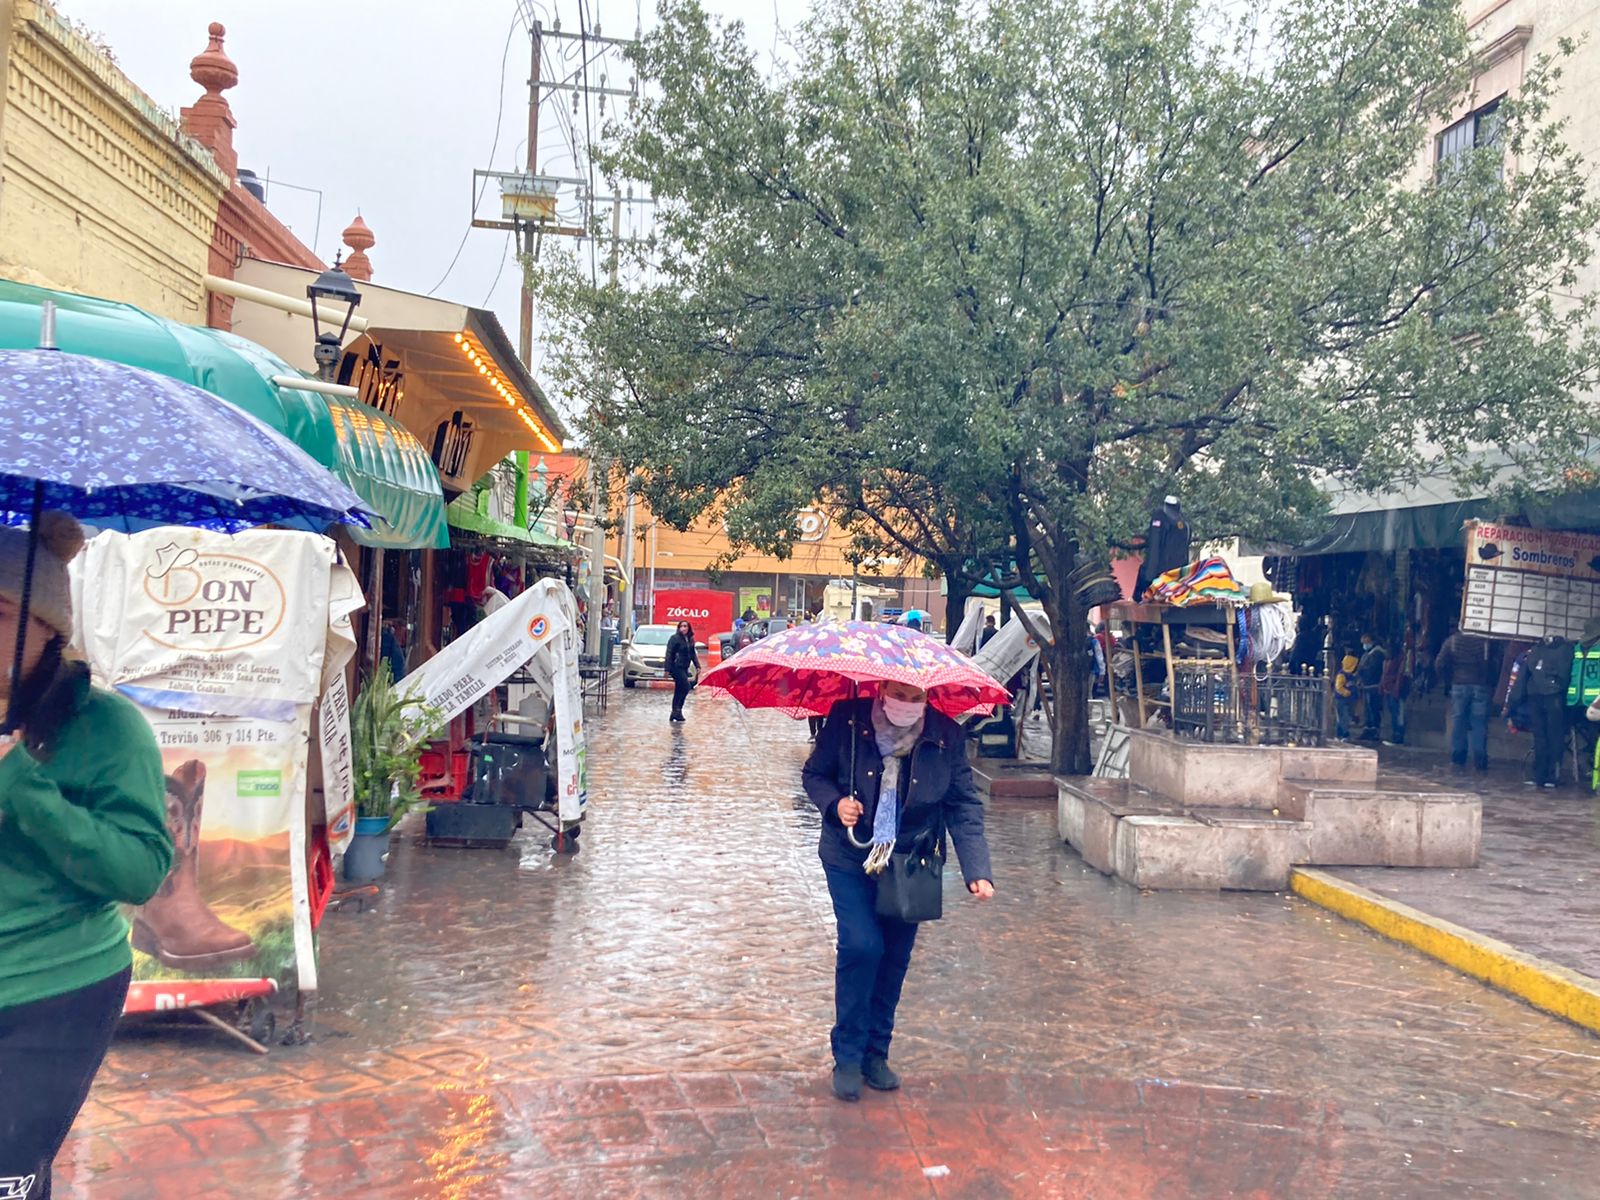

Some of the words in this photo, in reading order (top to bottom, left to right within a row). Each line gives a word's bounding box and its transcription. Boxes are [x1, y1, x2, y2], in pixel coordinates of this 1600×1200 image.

[1512, 546, 1576, 569] Sombreros
[164, 608, 265, 634] PEPE
[666, 605, 710, 618] ZÓCALO
[453, 673, 475, 692] PARA
[444, 700, 457, 713] LA
[455, 679, 487, 705] FAMILIA
[160, 730, 199, 744] Treviño
[203, 729, 222, 743] 306
[226, 732, 233, 745] y
[236, 728, 252, 743] 314
[257, 728, 278, 743] Pte.
